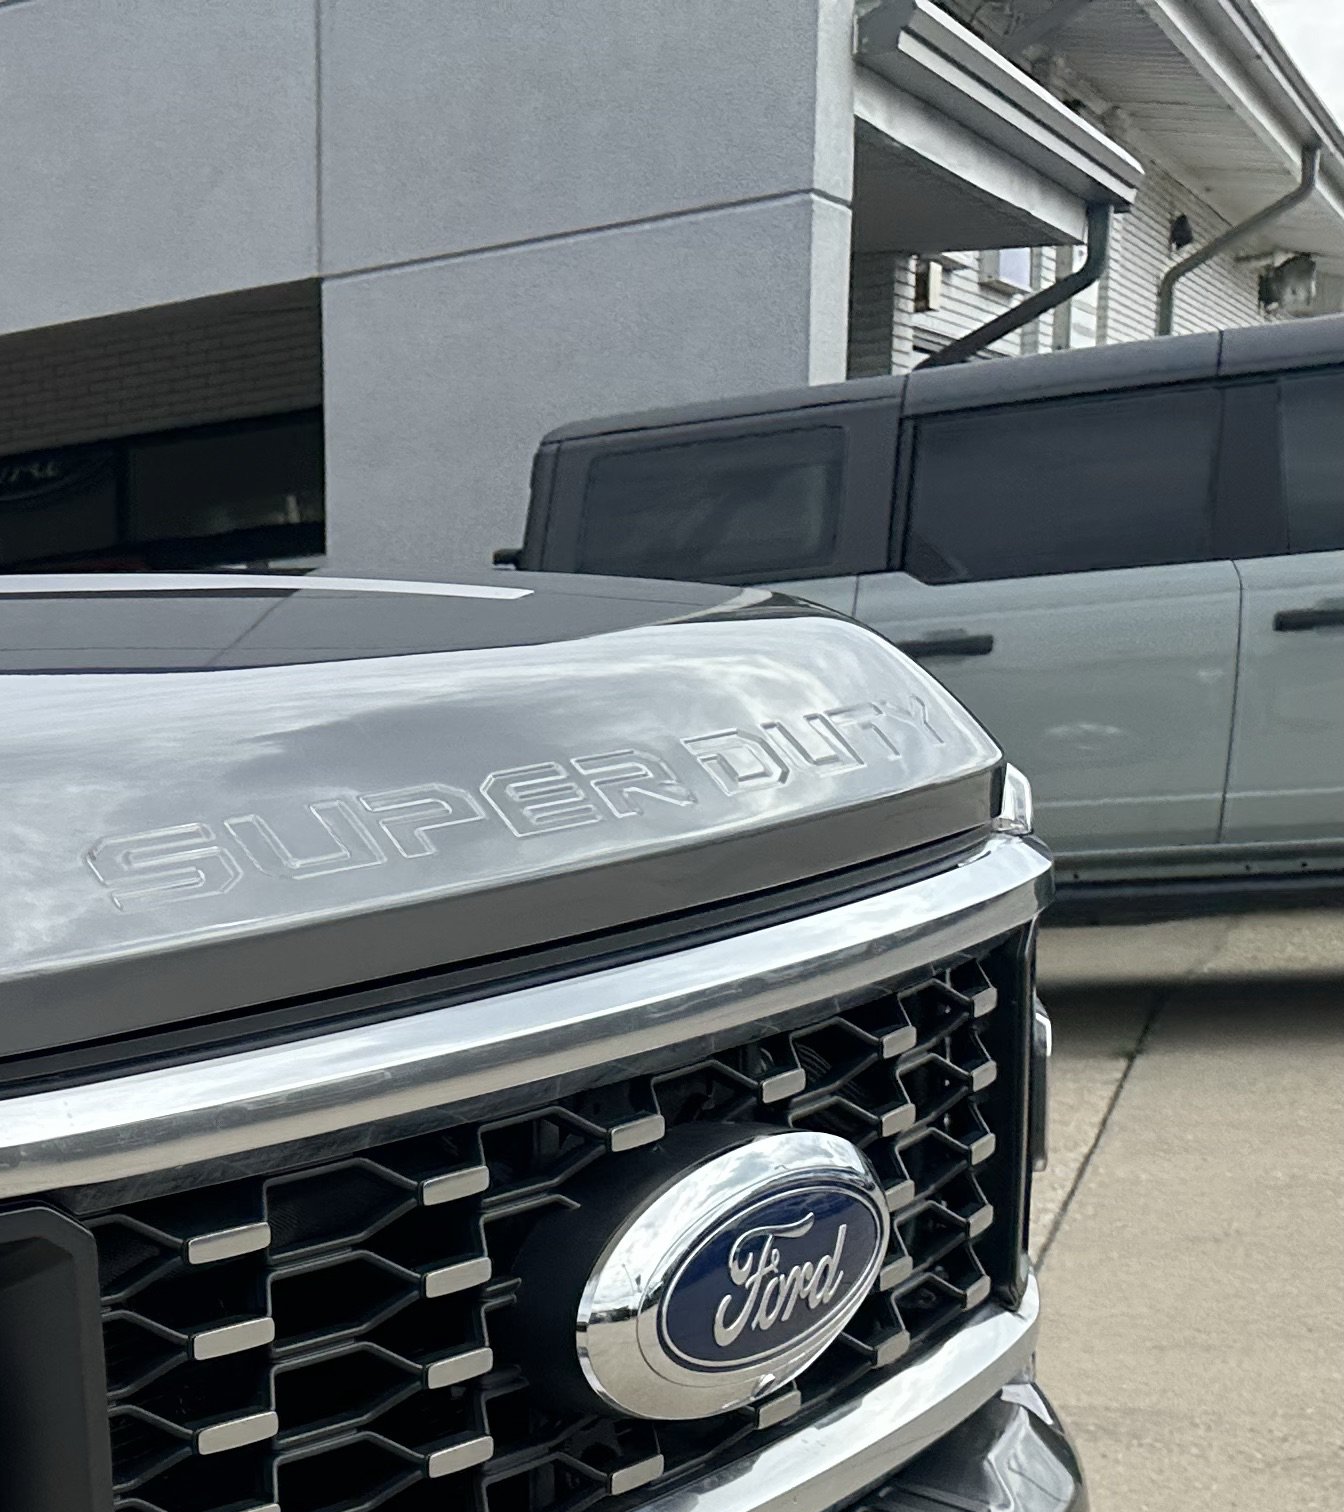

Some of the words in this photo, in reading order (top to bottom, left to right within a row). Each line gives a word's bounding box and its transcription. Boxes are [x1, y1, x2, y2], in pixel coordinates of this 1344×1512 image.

[86, 748, 700, 913] SUPER
[679, 693, 946, 798] DUTY
[713, 1211, 848, 1347] Ford
